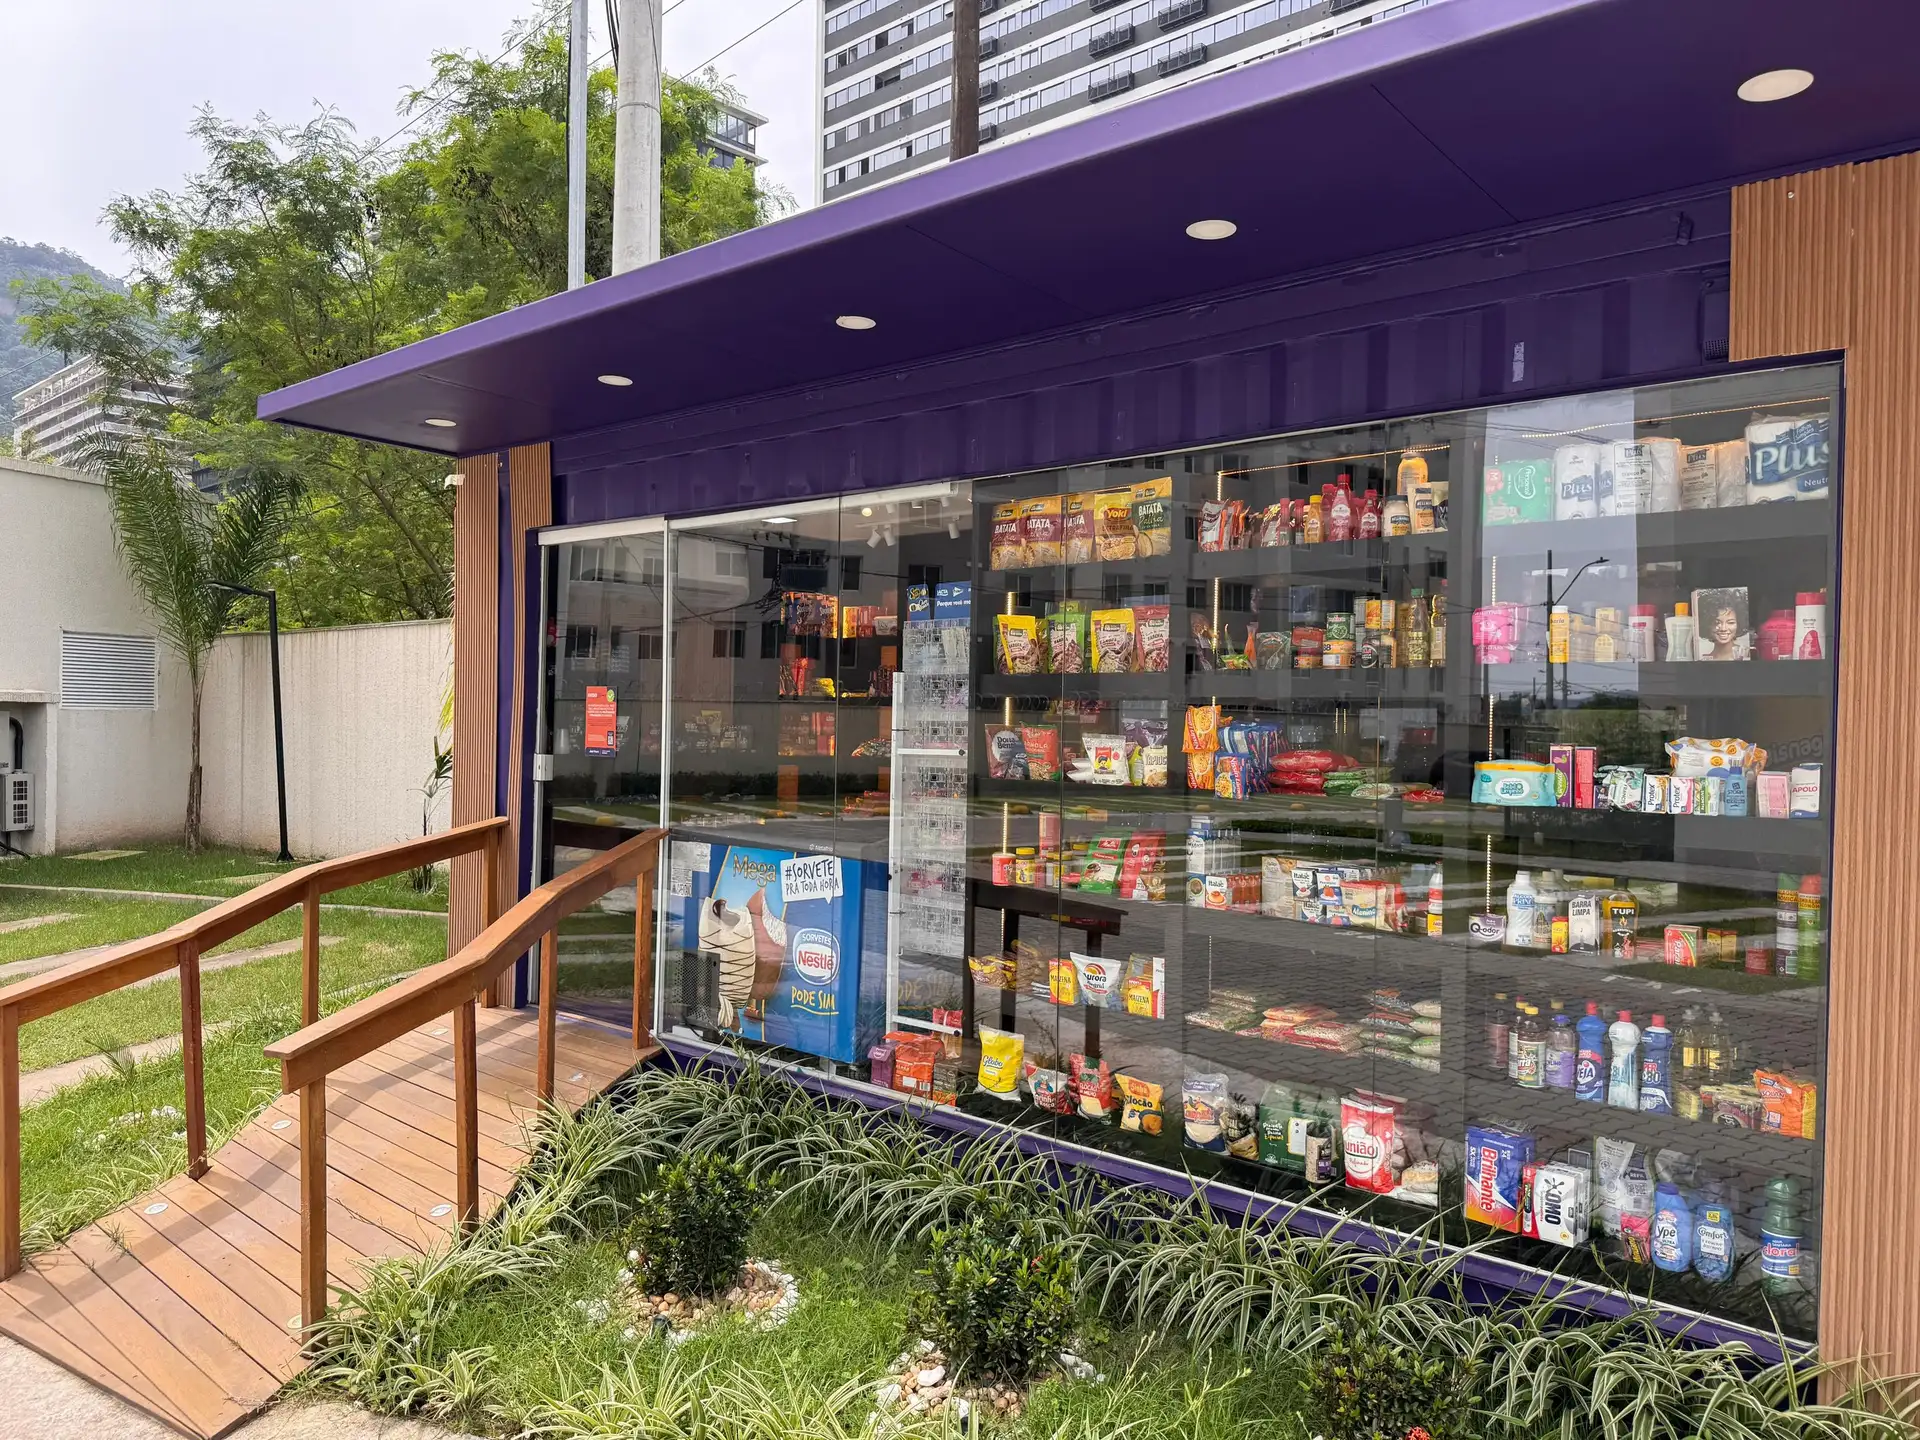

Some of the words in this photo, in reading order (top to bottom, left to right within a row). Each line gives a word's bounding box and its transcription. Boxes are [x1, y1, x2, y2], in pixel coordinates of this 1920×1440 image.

[1755, 442, 1829, 480] Plus
[1563, 481, 1593, 497] Plus
[1107, 509, 1128, 518] Yoki
[1139, 502, 1163, 516] BATATA
[995, 523, 1017, 534] BATATA
[1648, 783, 1656, 806] Protex
[1673, 785, 1681, 808] Protex
[733, 854, 776, 887] Mega
[785, 859, 834, 882] #SORVETE
[786, 883, 799, 895] PRA
[801, 880, 817, 892] TODA
[1571, 900, 1592, 908] BARRA
[1470, 922, 1500, 935] Q-odor
[802, 933, 832, 945] SORVETES
[792, 986, 816, 1006] PODE
[818, 990, 835, 1010] SIM
[1346, 1141, 1374, 1156] união
[1481, 1147, 1498, 1211] Brilhante
[1545, 1193, 1561, 1225] OMO
